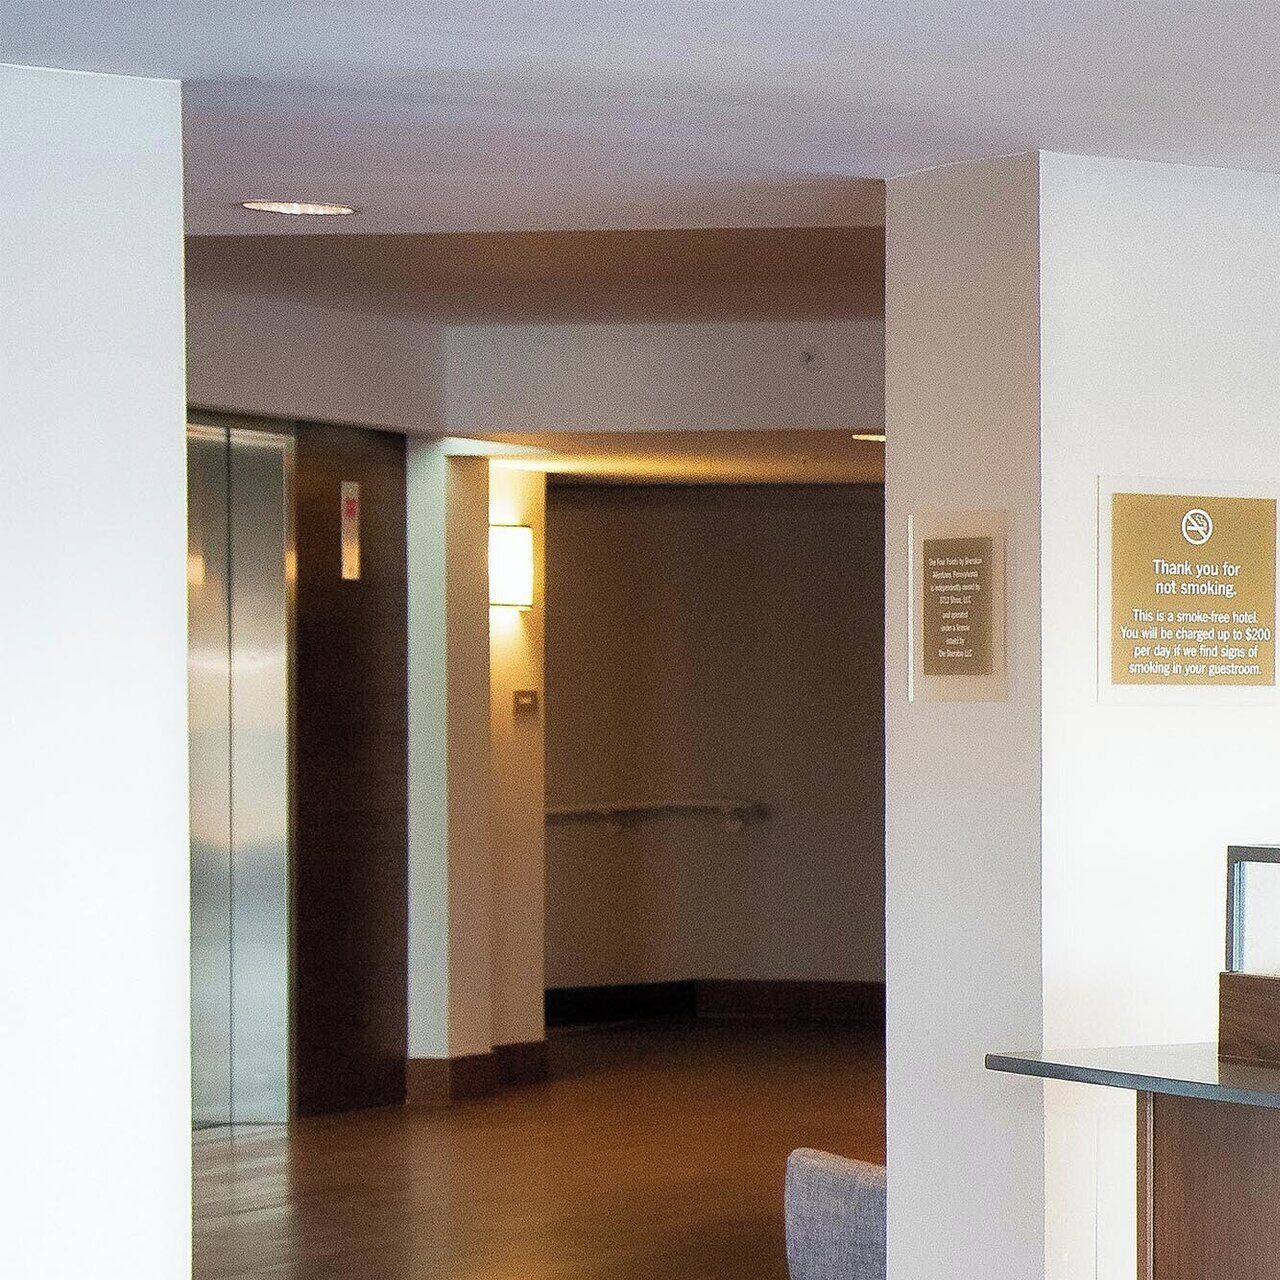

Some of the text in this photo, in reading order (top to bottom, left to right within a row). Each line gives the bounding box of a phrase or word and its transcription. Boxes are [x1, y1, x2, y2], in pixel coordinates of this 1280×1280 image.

[1153, 559, 1240, 578] Thank you for
[1155, 580, 1237, 598] not smoking.
[1133, 608, 1258, 624] This is a smoke-free hotel.
[1120, 626, 1271, 642] You will be charged up to $200
[1134, 644, 1258, 660] per day if we find signs of
[1129, 661, 1262, 677] smoking in your guestroom.
